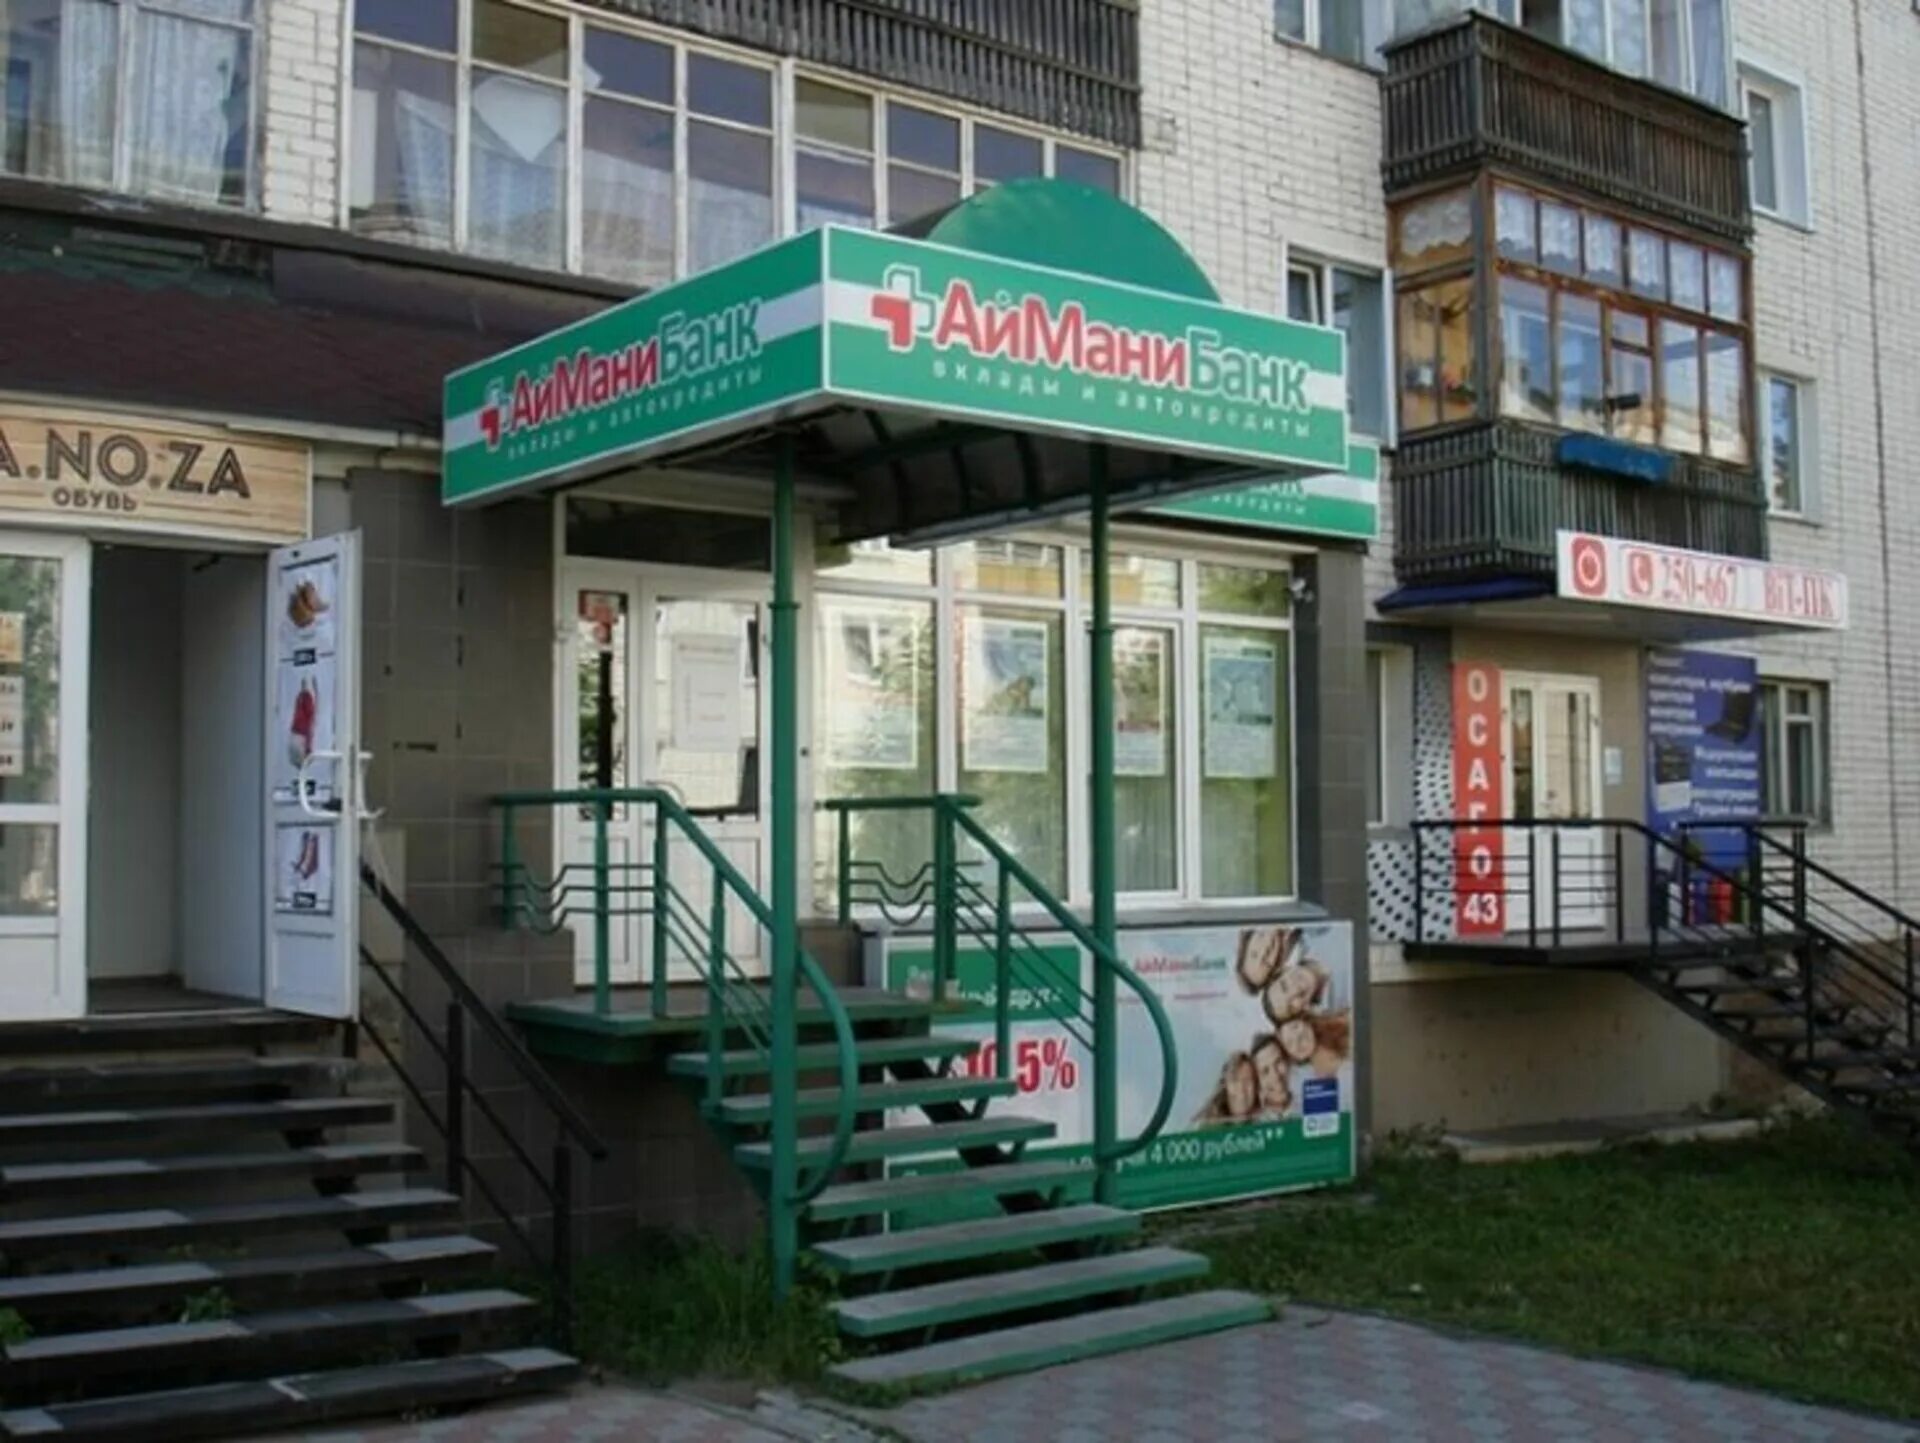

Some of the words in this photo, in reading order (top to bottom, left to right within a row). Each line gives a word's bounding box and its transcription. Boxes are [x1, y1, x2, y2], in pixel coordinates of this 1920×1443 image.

[508, 296, 763, 437] АйМаниБанк
[932, 277, 1312, 415] АйМаниБанк
[933, 359, 1060, 396] вклады
[1082, 385, 1096, 401] и
[1117, 390, 1311, 438] автокредиты
[53, 486, 138, 512] ОБУВЬ
[1466, 668, 1494, 880] ОСАГО
[1463, 892, 1499, 925] 43
[1150, 1143, 1165, 1165] 4
[1168, 1138, 1200, 1164] 000
